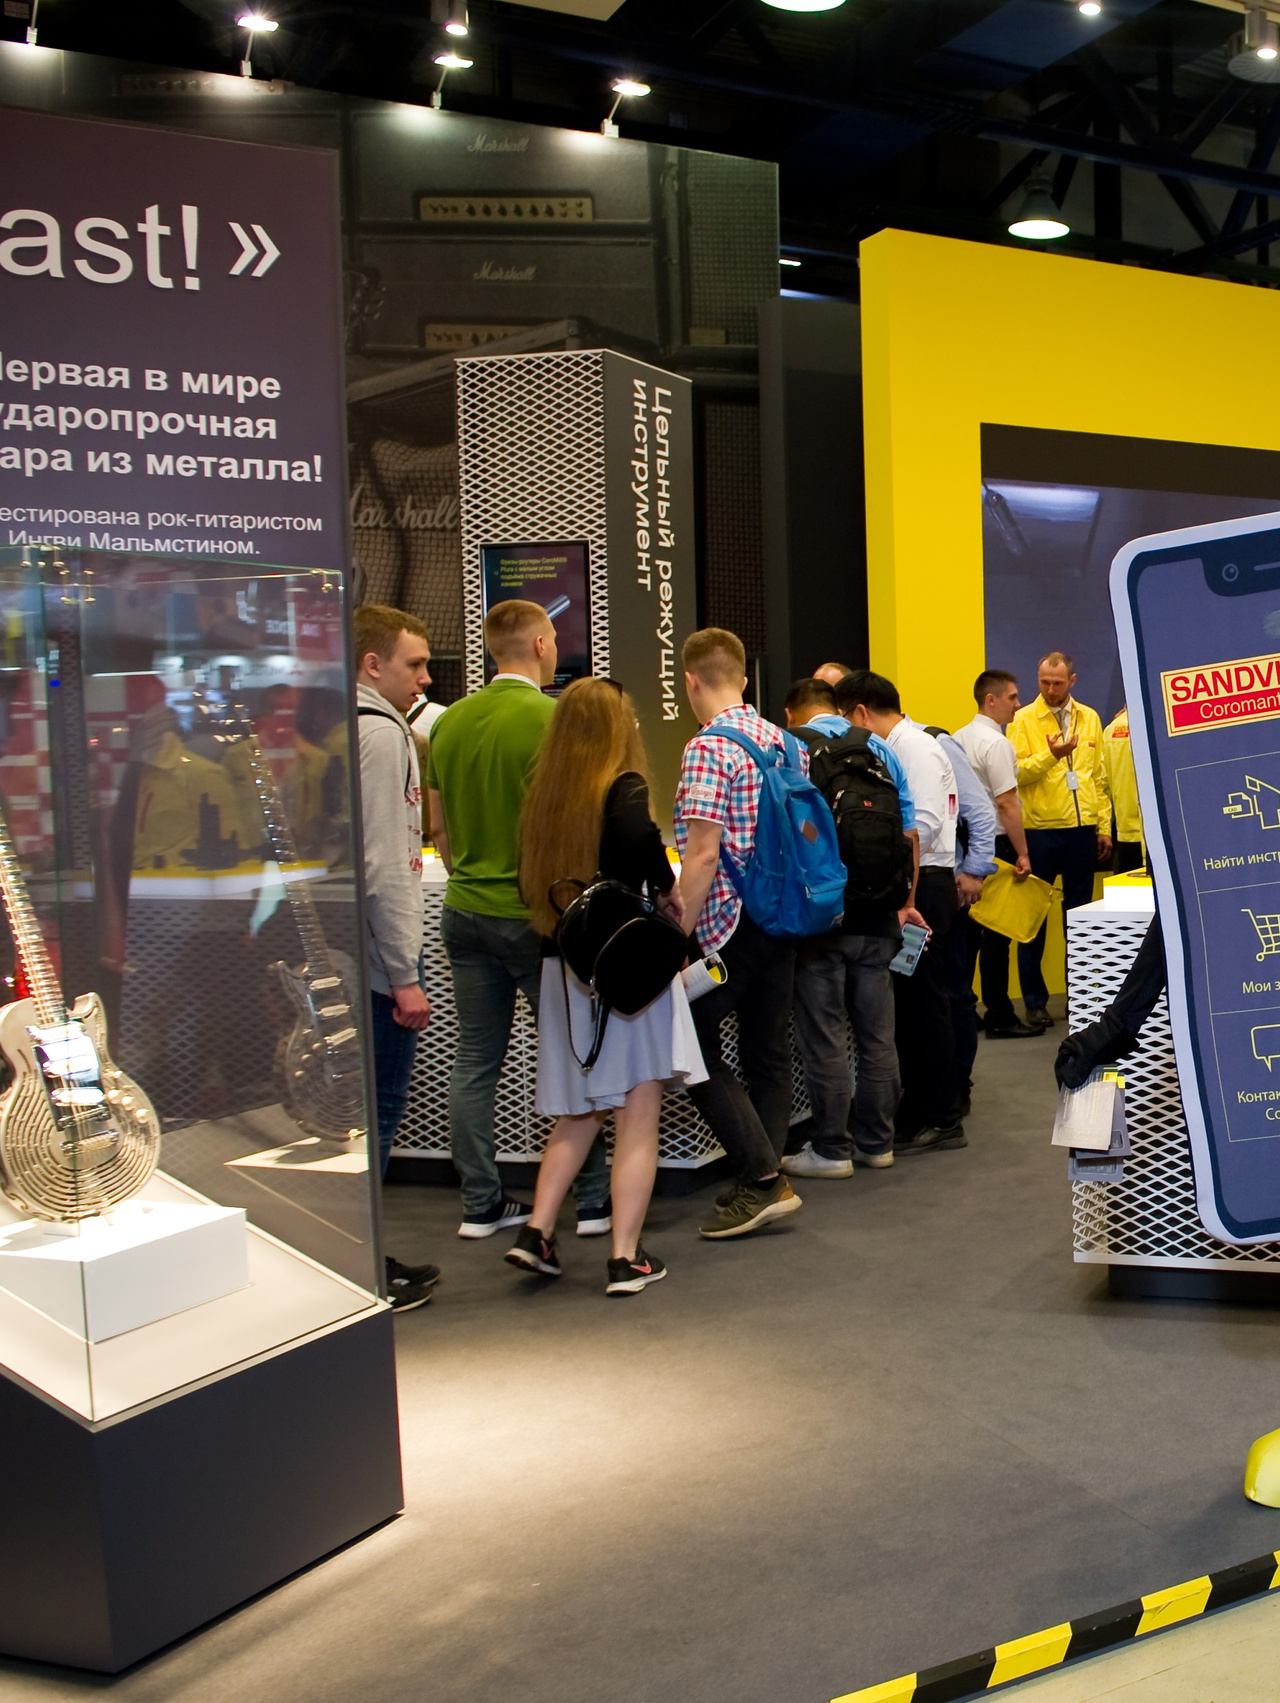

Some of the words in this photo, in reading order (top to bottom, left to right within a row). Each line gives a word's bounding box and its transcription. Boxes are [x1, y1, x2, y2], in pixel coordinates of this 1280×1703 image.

[467, 133, 530, 153] Marshall
[473, 261, 536, 281] Marshall
[0, 352, 131, 391] ервая
[144, 368, 169, 392] в
[181, 371, 282, 404] мире
[86, 450, 133, 475] из
[146, 452, 323, 483] металла!
[651, 385, 676, 549] Цельный
[631, 378, 652, 592] инструмент
[147, 509, 323, 533] рок-гитаристом
[8, 530, 82, 549] Ингви
[89, 531, 261, 555] Мальмстином.
[655, 559, 680, 721] режущий
[1203, 855, 1245, 871] Найти
[1242, 981, 1272, 994] Мои
